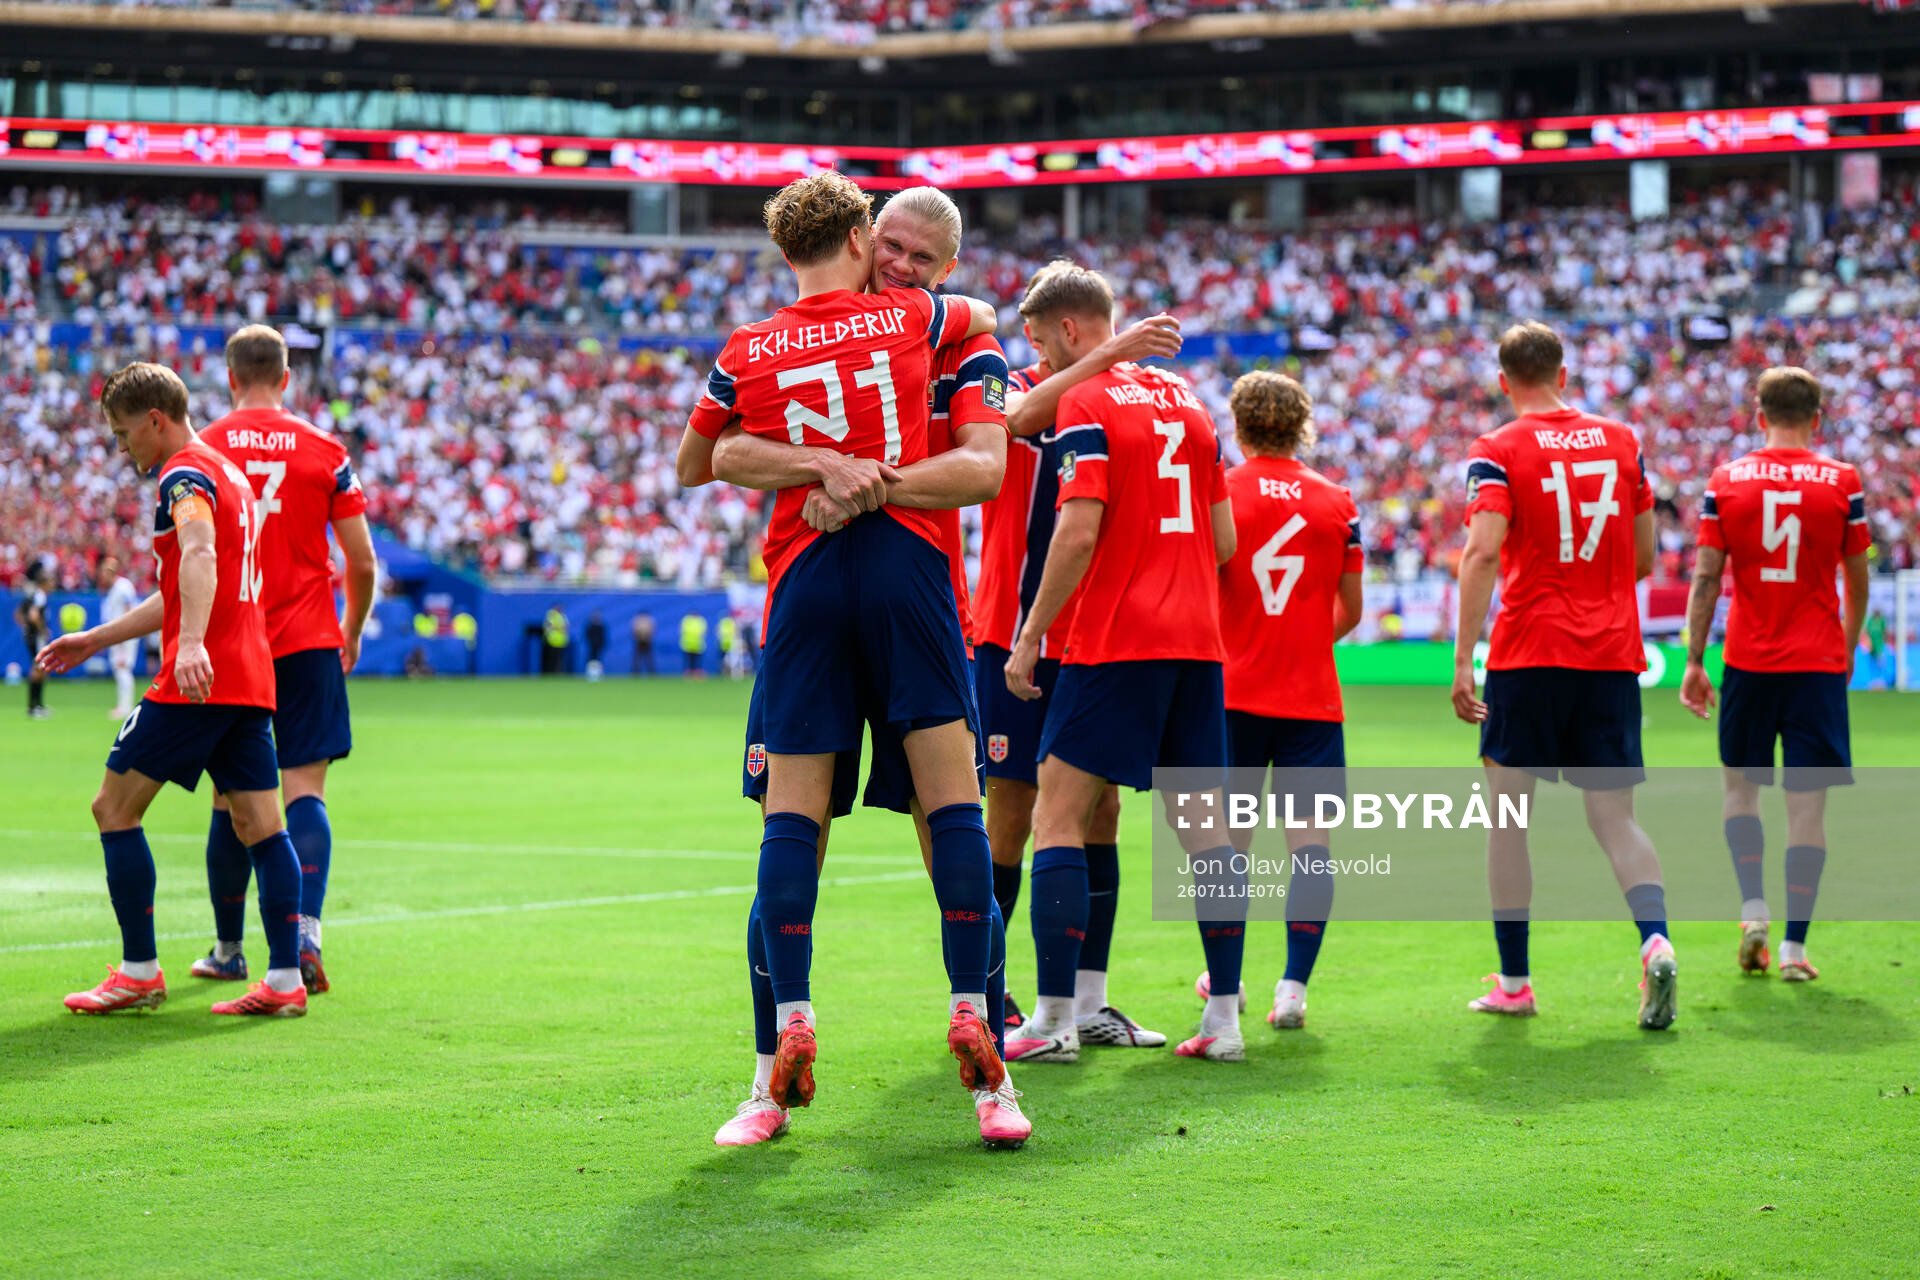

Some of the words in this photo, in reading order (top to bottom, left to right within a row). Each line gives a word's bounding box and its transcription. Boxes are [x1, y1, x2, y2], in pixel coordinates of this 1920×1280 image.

[748, 307, 907, 363] SCHJELDERUP
[776, 350, 902, 465] 21
[246, 459, 287, 531] 7
[1153, 419, 1194, 533] 3
[1259, 477, 1302, 500] BERG
[1541, 459, 1619, 563] 17
[1252, 512, 1307, 615] 6
[1760, 490, 1802, 583] 5
